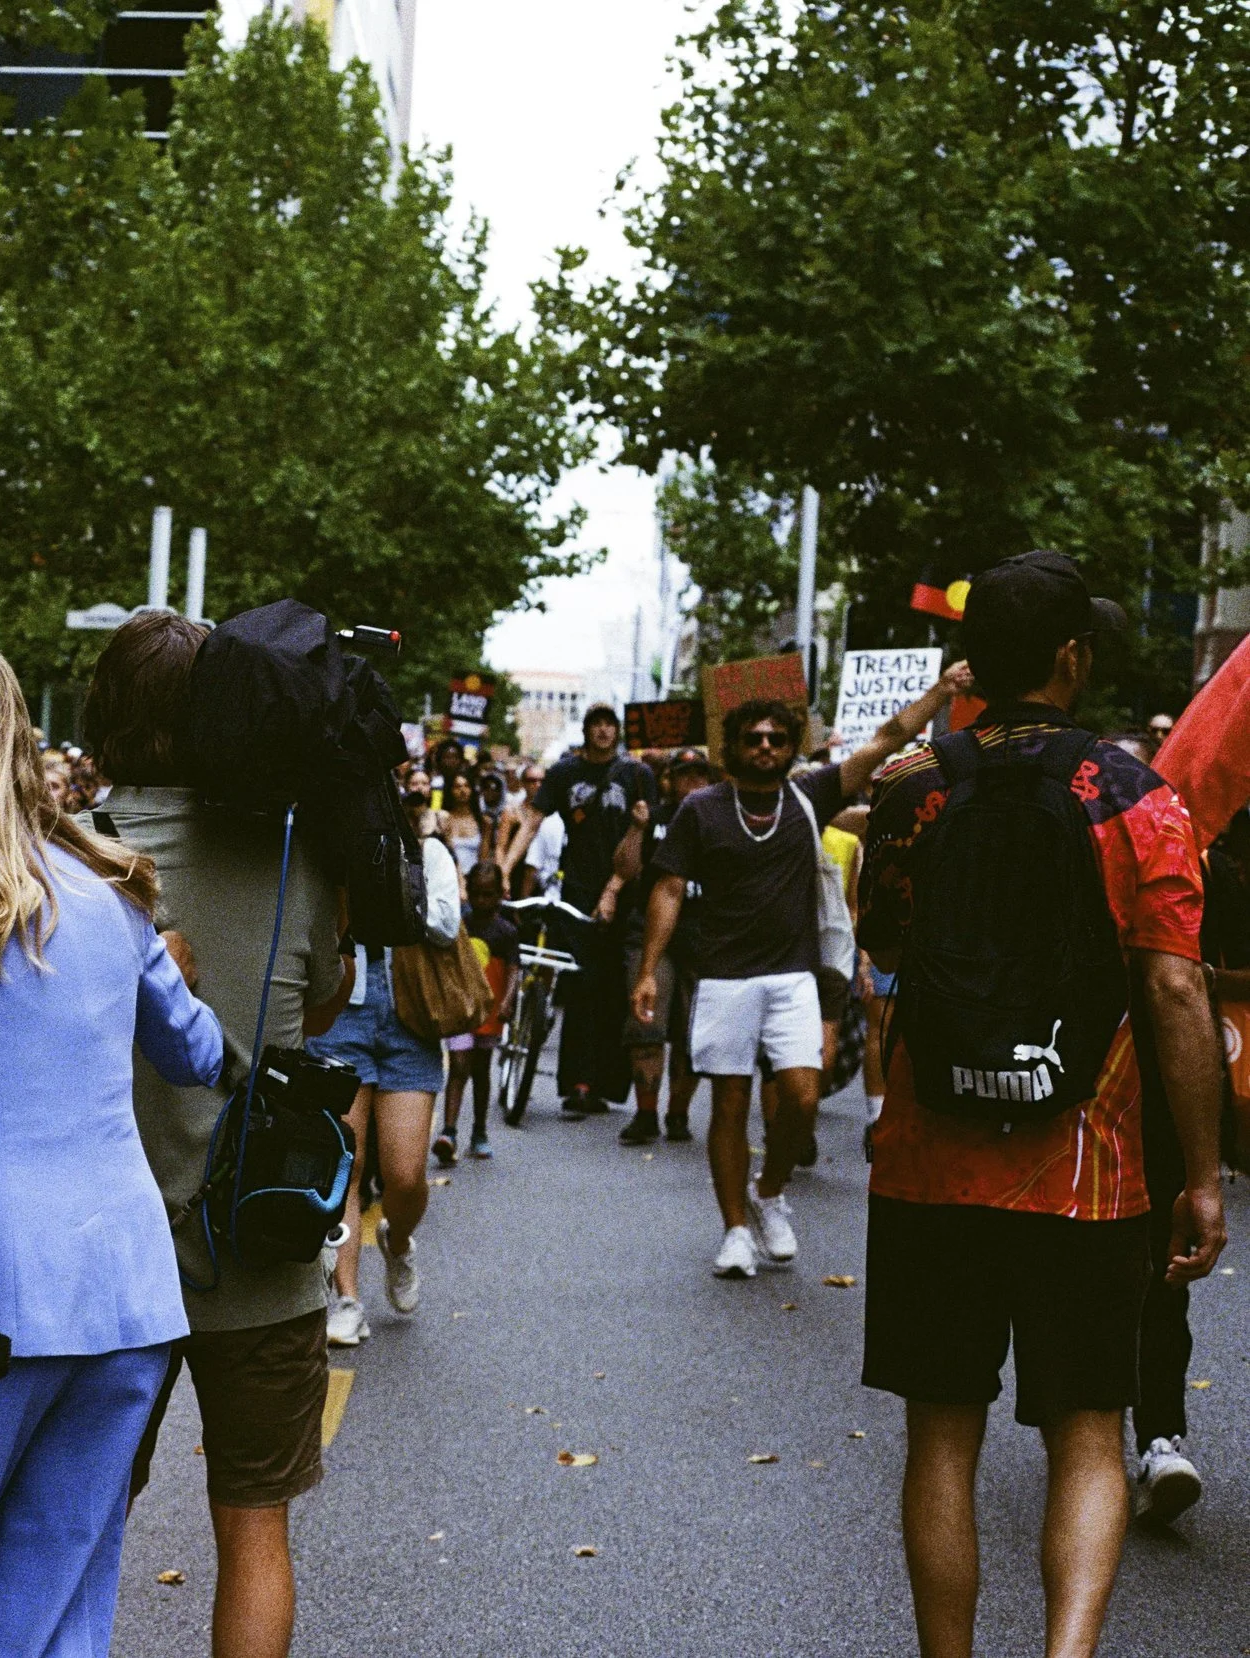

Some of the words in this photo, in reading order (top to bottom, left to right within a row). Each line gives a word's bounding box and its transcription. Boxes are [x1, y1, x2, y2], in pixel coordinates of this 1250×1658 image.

[852, 654, 928, 675] TREATY
[845, 675, 931, 698] JUSTICE
[952, 1063, 1054, 1102] PUMA
